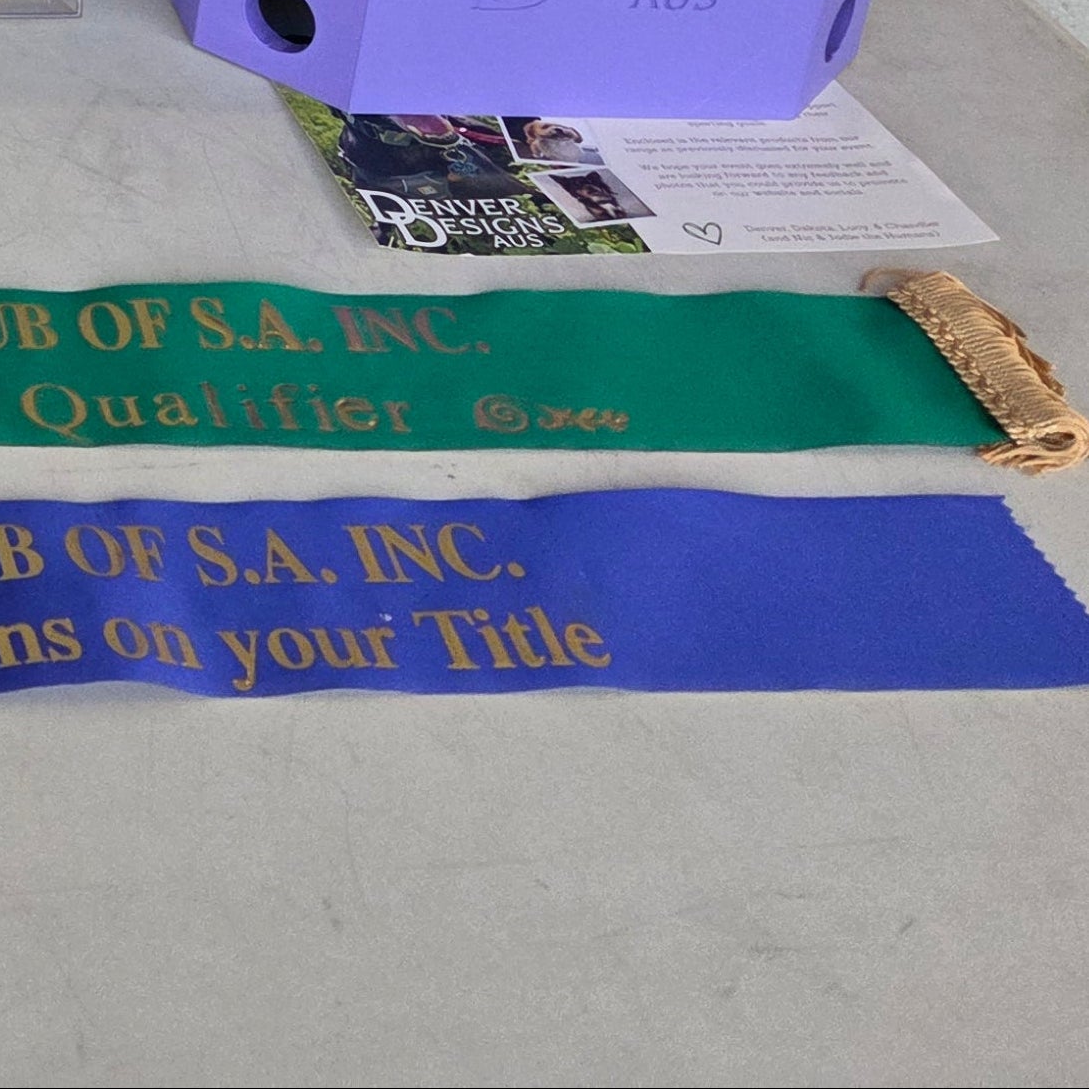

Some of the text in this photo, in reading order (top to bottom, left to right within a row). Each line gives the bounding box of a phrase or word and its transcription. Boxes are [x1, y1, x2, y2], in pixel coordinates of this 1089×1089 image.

[355, 188, 526, 225] DENVER
[384, 211, 565, 248] DESIGNS
[494, 233, 545, 248] AUS
[77, 297, 172, 351] OF
[190, 297, 324, 352] S.A.
[331, 305, 491, 355] INC.
[19, 381, 412, 447] Qualifier
[63, 524, 167, 582] OF
[187, 525, 337, 586] S.A.
[343, 522, 526, 583] INC.
[103, 617, 204, 670] on
[217, 622, 398, 691] your
[413, 607, 611, 670] Title
